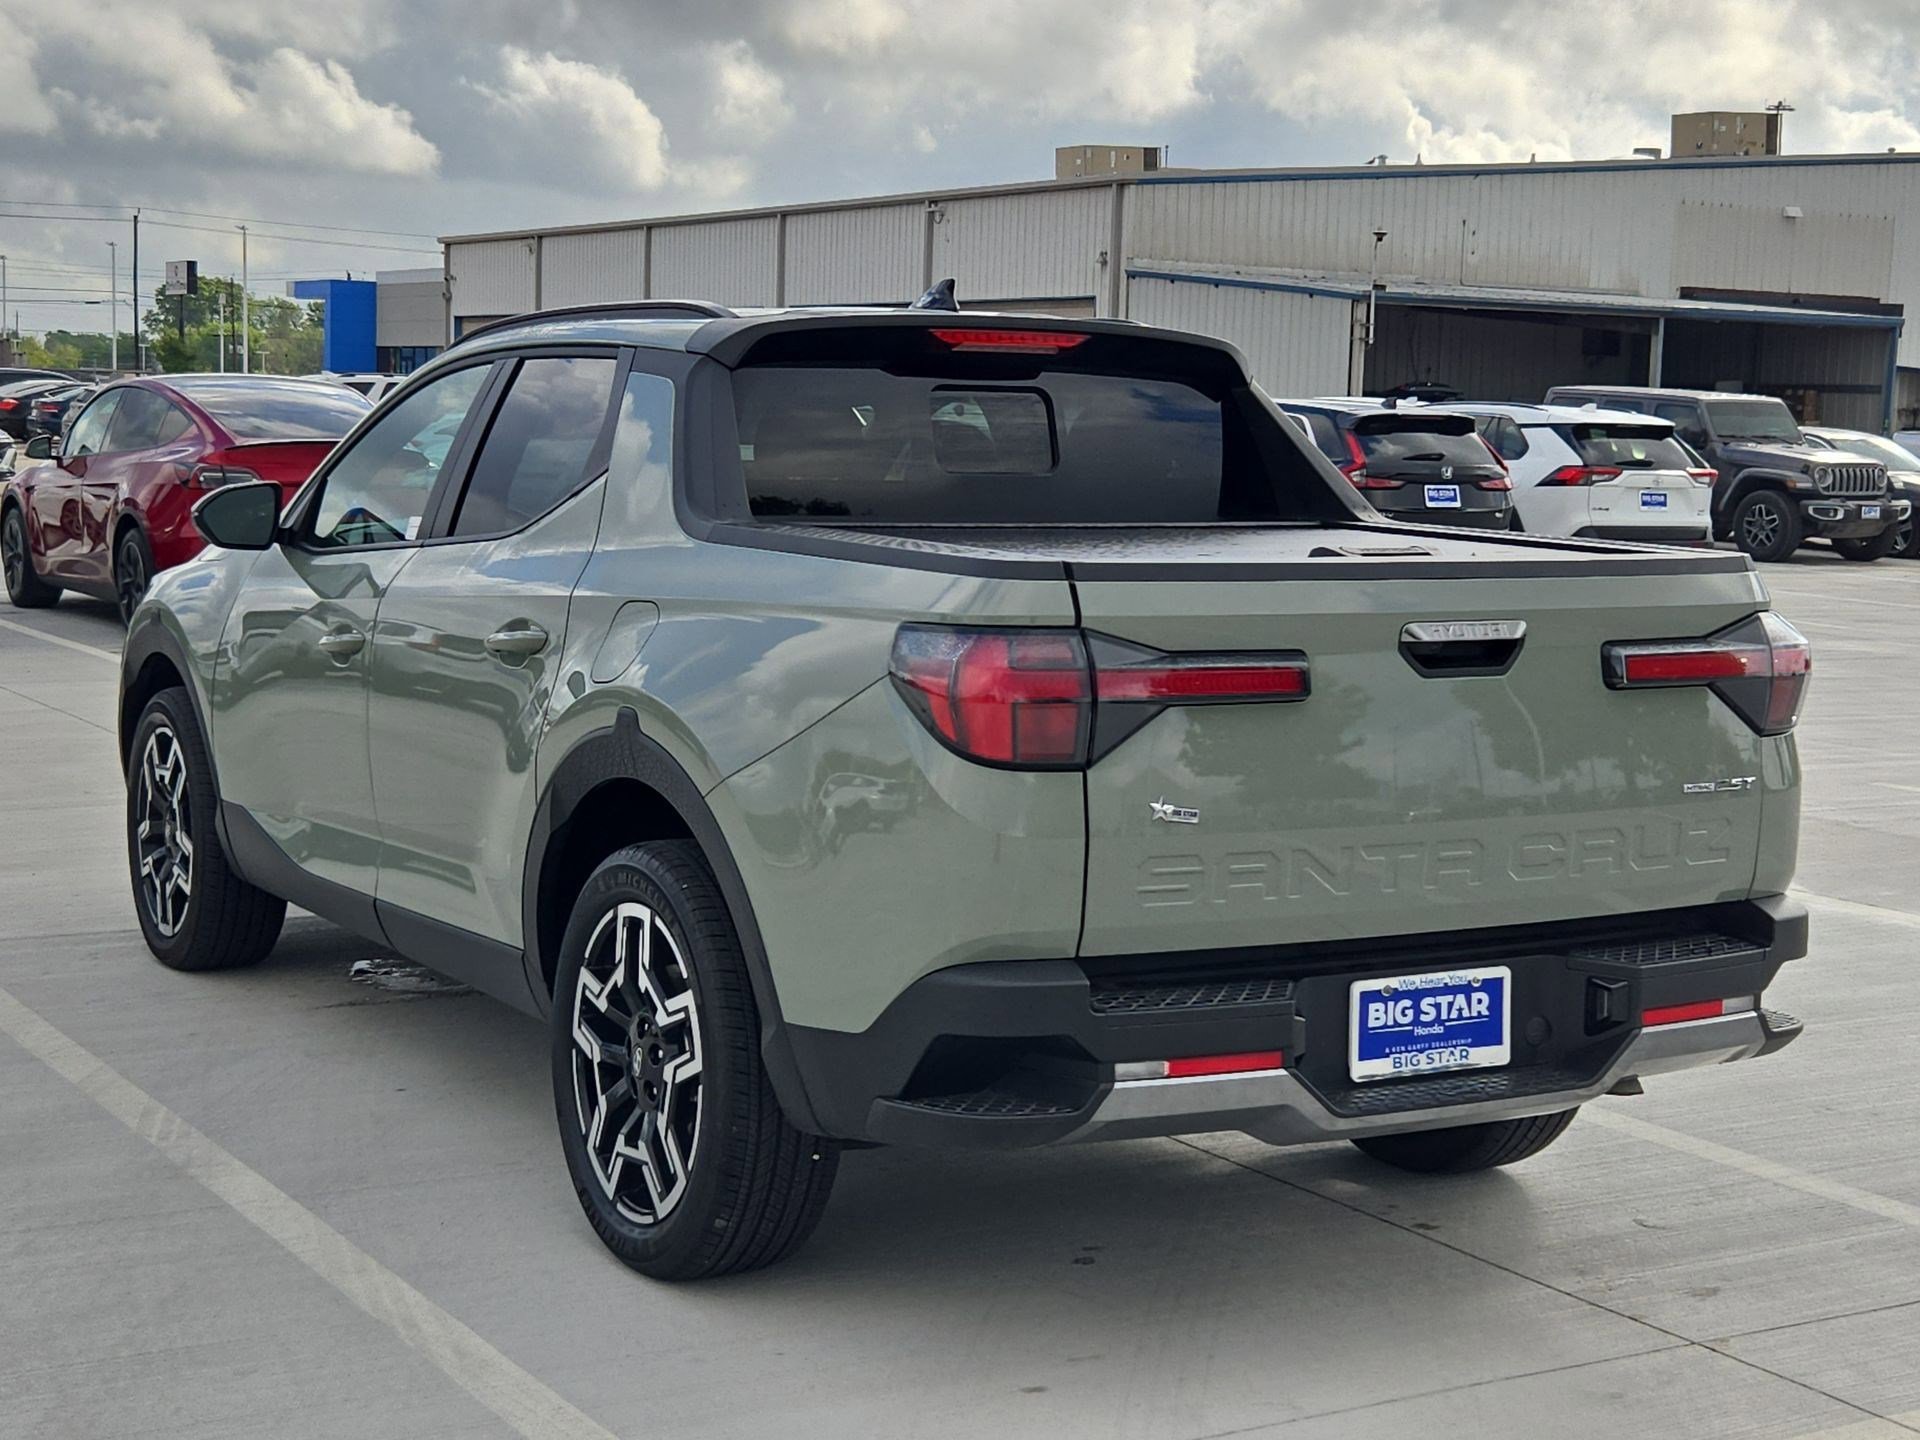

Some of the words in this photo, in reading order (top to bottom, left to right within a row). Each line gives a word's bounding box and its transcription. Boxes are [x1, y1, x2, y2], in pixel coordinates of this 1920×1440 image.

[1137, 838, 1481, 906] SANTA
[1508, 817, 1731, 881] CRUZ
[1399, 979, 1416, 989] We
[1419, 976, 1445, 987] Hear
[1447, 974, 1468, 985] You
[1368, 999, 1414, 1028] BIG
[1419, 992, 1490, 1022] STAR
[1413, 1023, 1444, 1036] Honda
[1393, 1054, 1420, 1069] BIG
[1425, 1048, 1470, 1065] STAR
